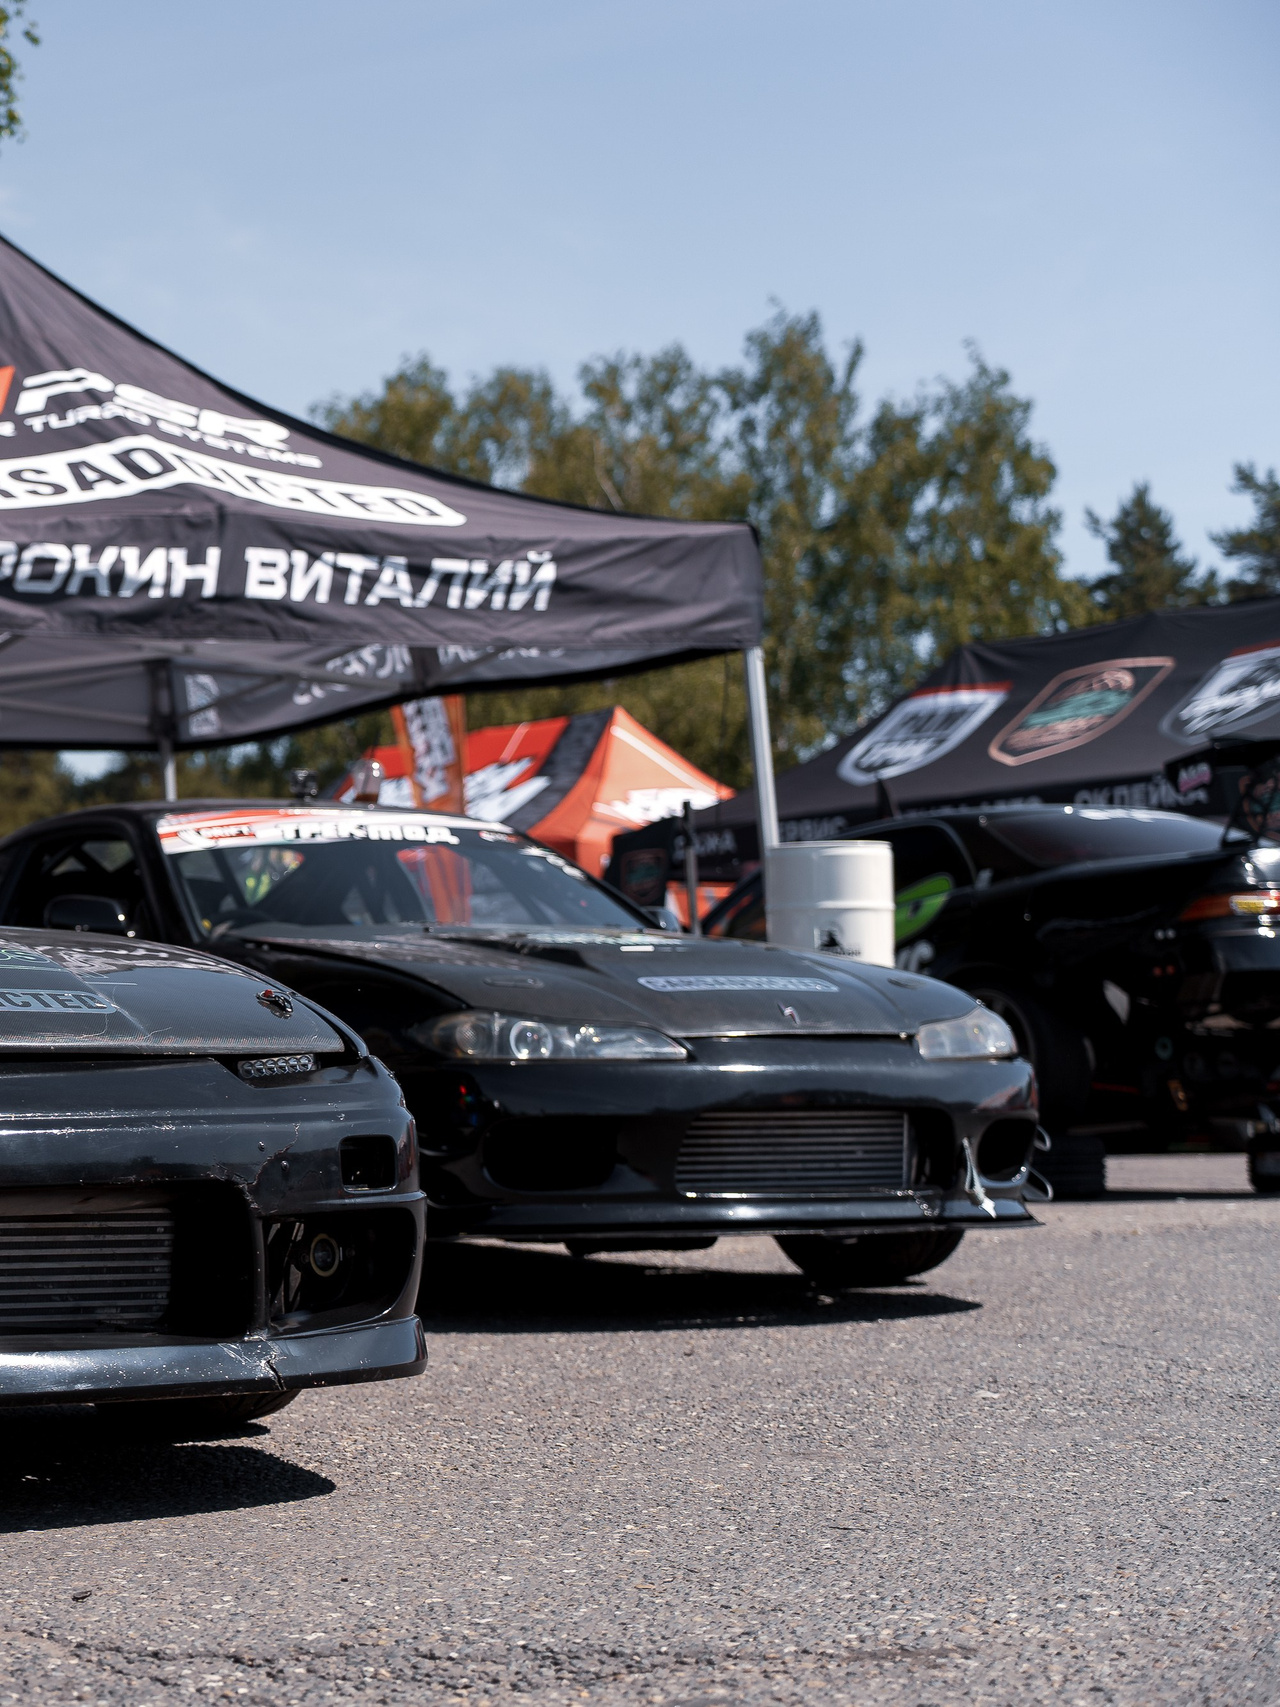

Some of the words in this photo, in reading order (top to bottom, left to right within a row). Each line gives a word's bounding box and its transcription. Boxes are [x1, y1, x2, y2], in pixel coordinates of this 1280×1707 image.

[15, 367, 291, 450] PSR
[155, 418, 323, 469] SYSTEMS
[243, 546, 559, 612] ВИТАЛИЙ
